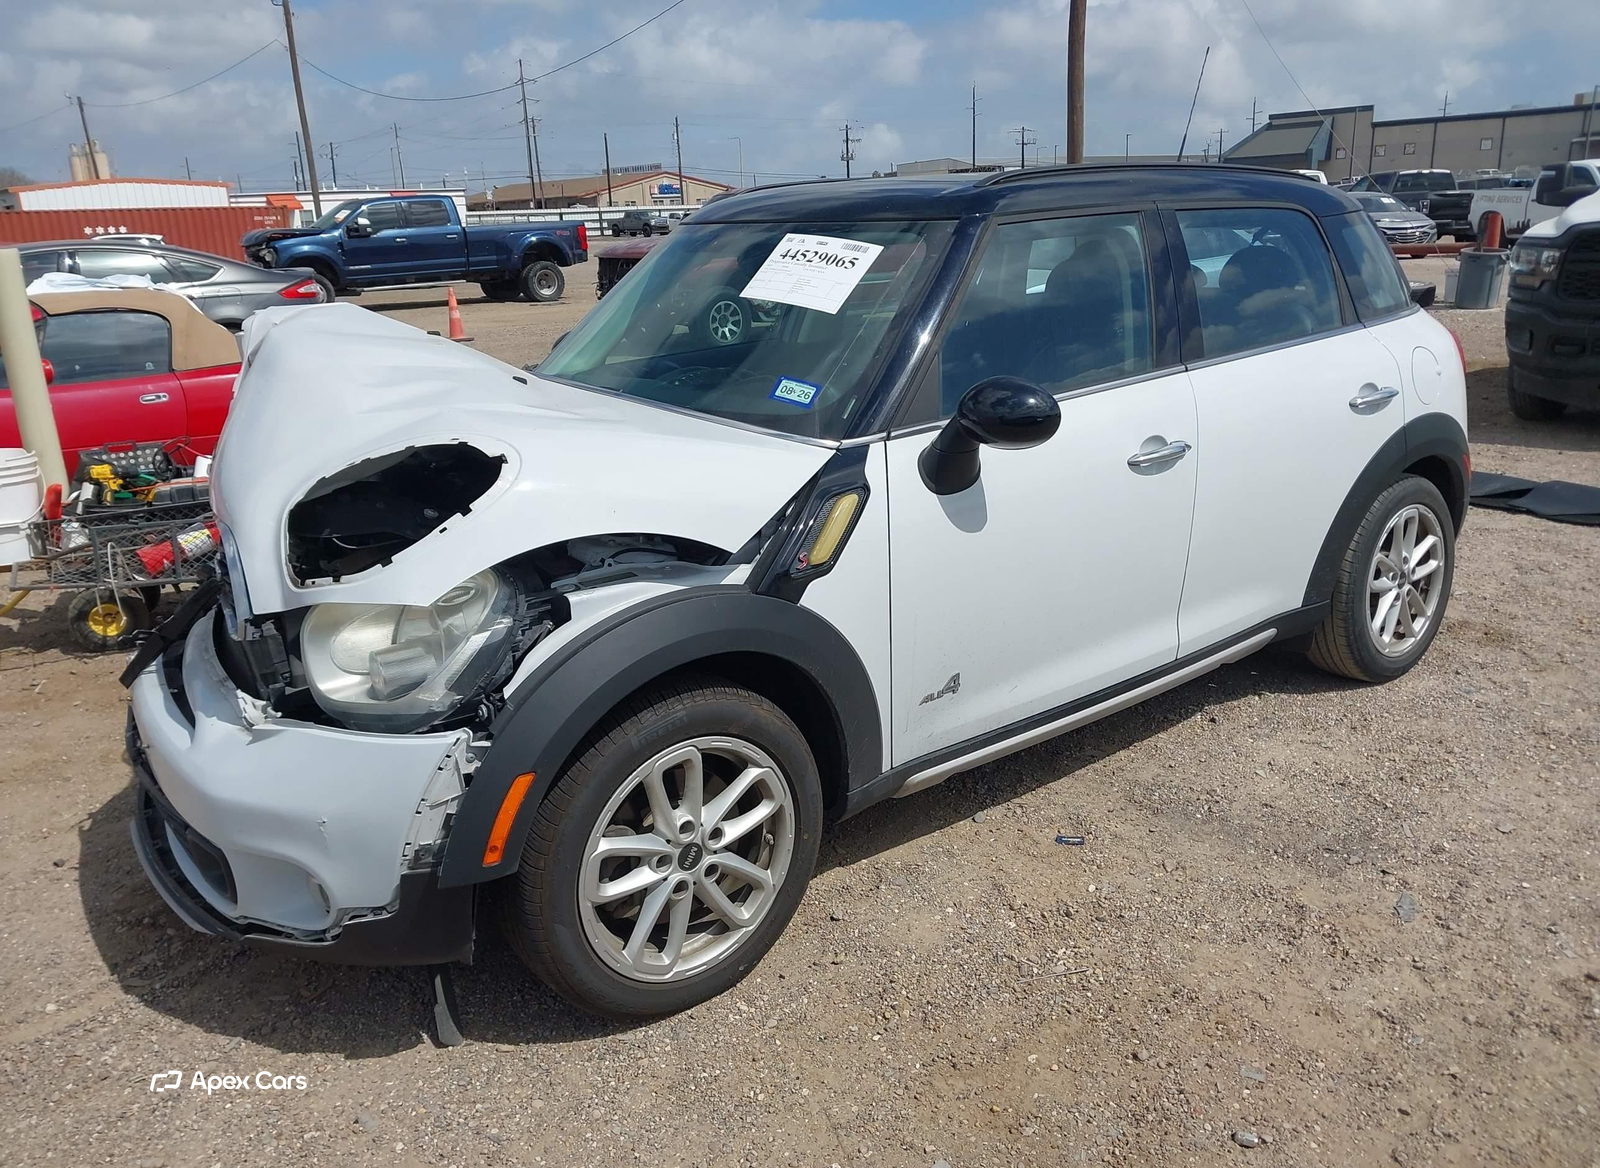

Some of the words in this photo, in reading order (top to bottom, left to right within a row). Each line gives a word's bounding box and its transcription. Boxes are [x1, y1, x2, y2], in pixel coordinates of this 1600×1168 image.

[1495, 195, 1523, 204] SERVICES
[780, 247, 859, 270] 44529065
[780, 385, 794, 395] 08
[797, 389, 812, 400] 26
[683, 846, 698, 868] MINI
